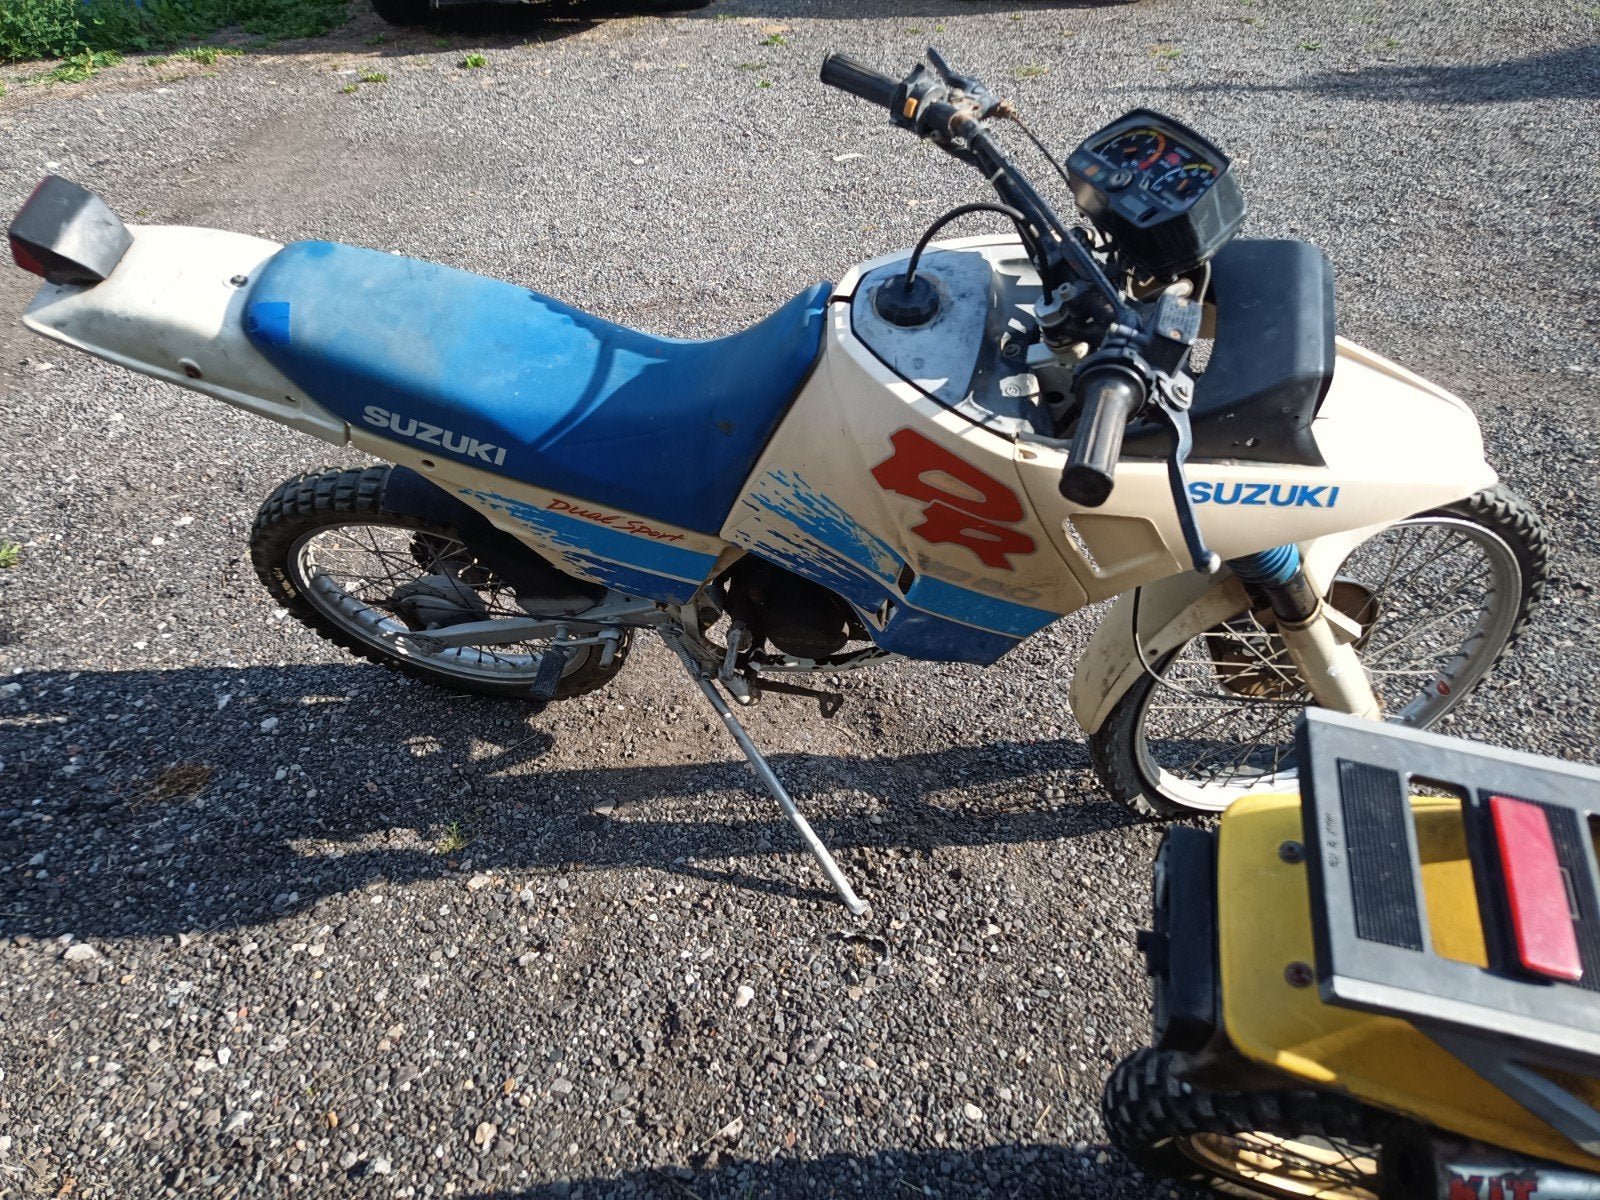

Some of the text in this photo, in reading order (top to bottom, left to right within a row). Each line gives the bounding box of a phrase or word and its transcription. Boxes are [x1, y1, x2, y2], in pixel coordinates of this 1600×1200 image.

[362, 405, 507, 466] SUZUKI
[1187, 481, 1340, 508] SUZUKI
[546, 498, 687, 542] Dual Sport
